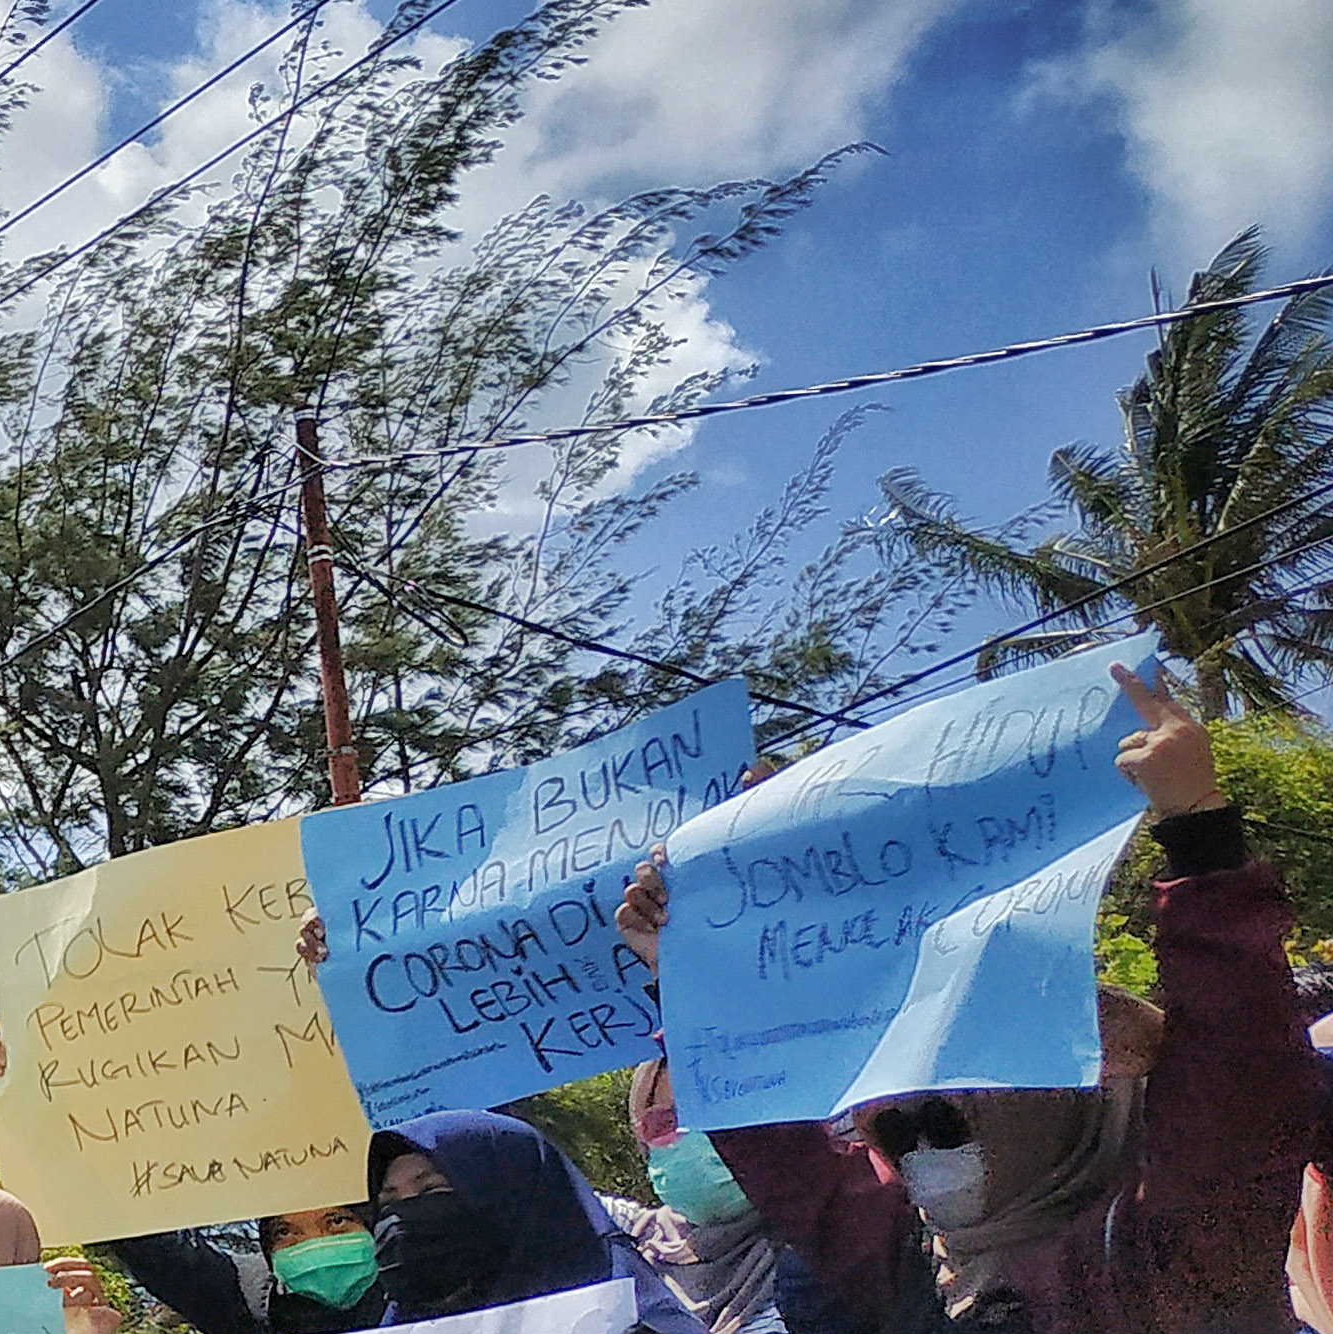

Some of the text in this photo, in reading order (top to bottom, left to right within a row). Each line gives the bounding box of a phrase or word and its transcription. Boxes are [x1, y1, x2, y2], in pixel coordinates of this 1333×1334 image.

[924, 686, 1110, 796] HIDUP
[361, 708, 701, 890] JIKA BUKAN
[352, 862, 506, 952] KARNA
[705, 832, 912, 928] JOMBLO
[15, 878, 315, 989] TOLAK KEB
[365, 919, 541, 1013] CORONA
[27, 955, 311, 1050] PEMERINTAH Y
[520, 995, 654, 1074] KERJ
[38, 1011, 335, 1101] RUGIKAN M
[232, 1136, 349, 1181] NATUNA
